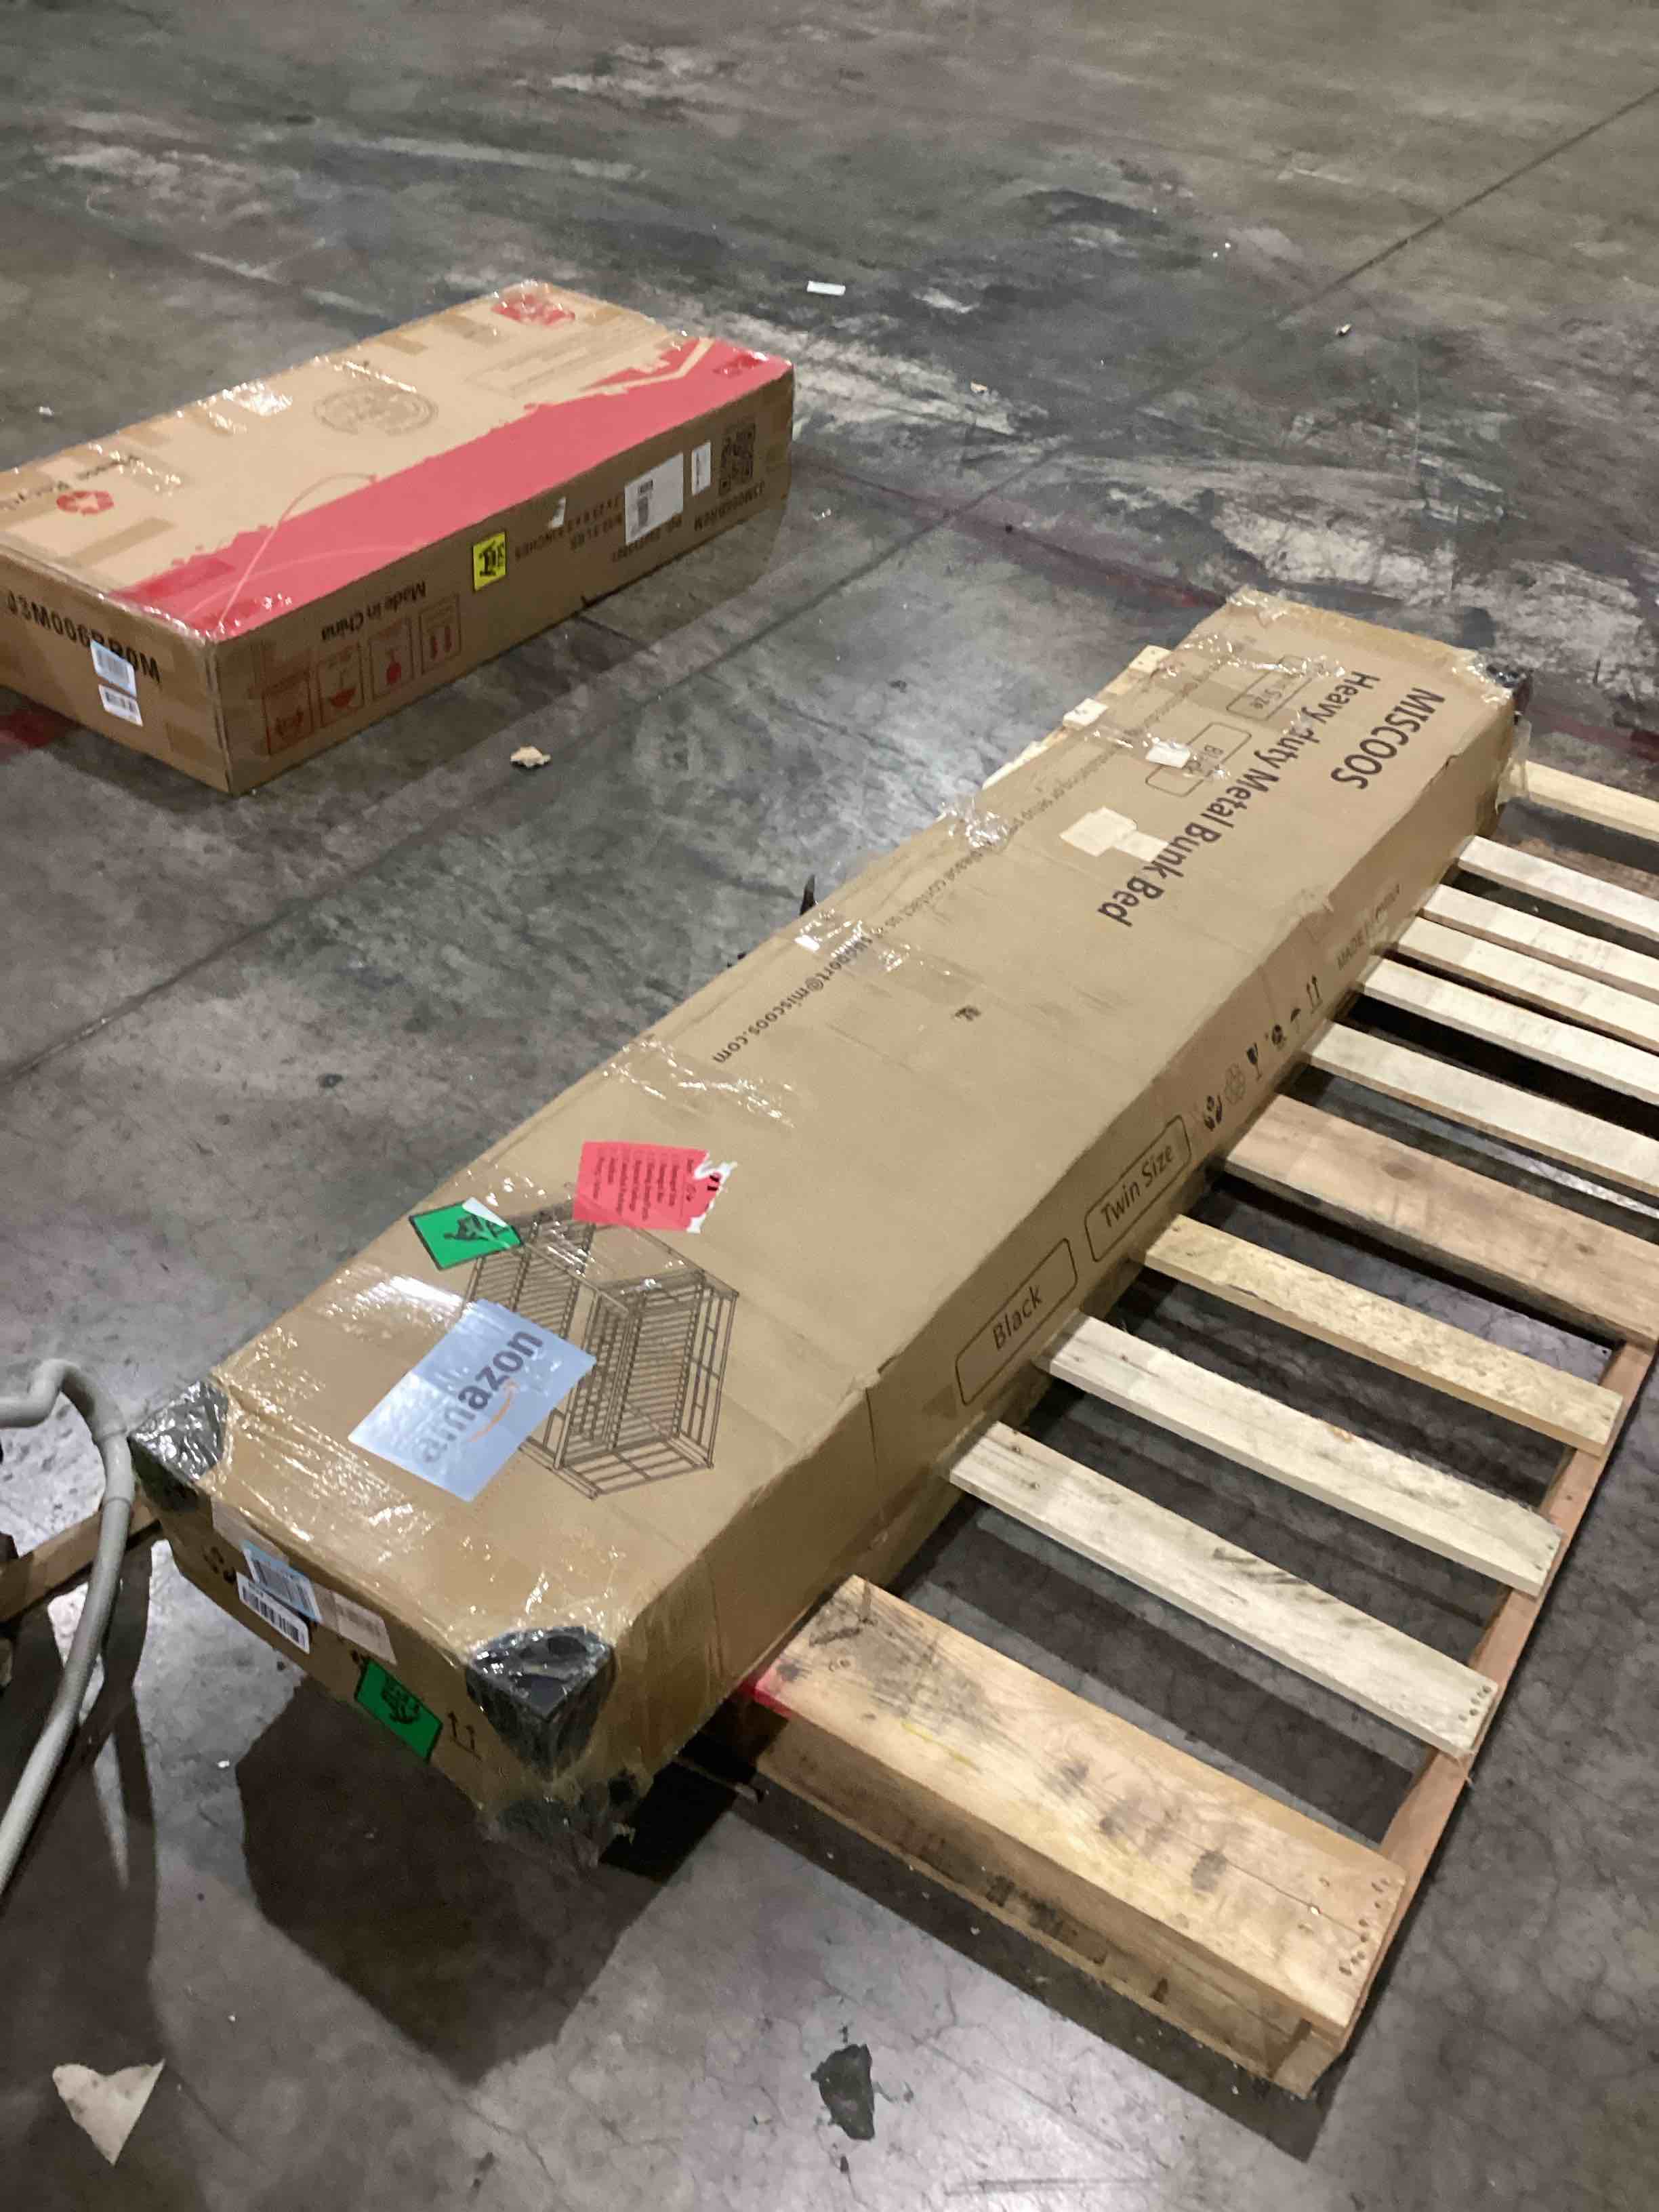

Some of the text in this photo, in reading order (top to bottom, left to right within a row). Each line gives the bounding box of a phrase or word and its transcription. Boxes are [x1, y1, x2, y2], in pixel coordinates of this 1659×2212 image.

[385, 581, 426, 612] Made
[322, 610, 365, 641] China
[1300, 671, 1381, 723] Heavy
[1254, 724, 1322, 768] duty
[1330, 687, 1446, 790] MISCOOS
[1201, 769, 1280, 827] Metal
[1143, 823, 1222, 879] Bunk
[1097, 877, 1165, 926] Bed
[1101, 1145, 1173, 1227] Twin Size
[994, 1286, 1042, 1351] Black
[422, 1330, 544, 1462] amazon
